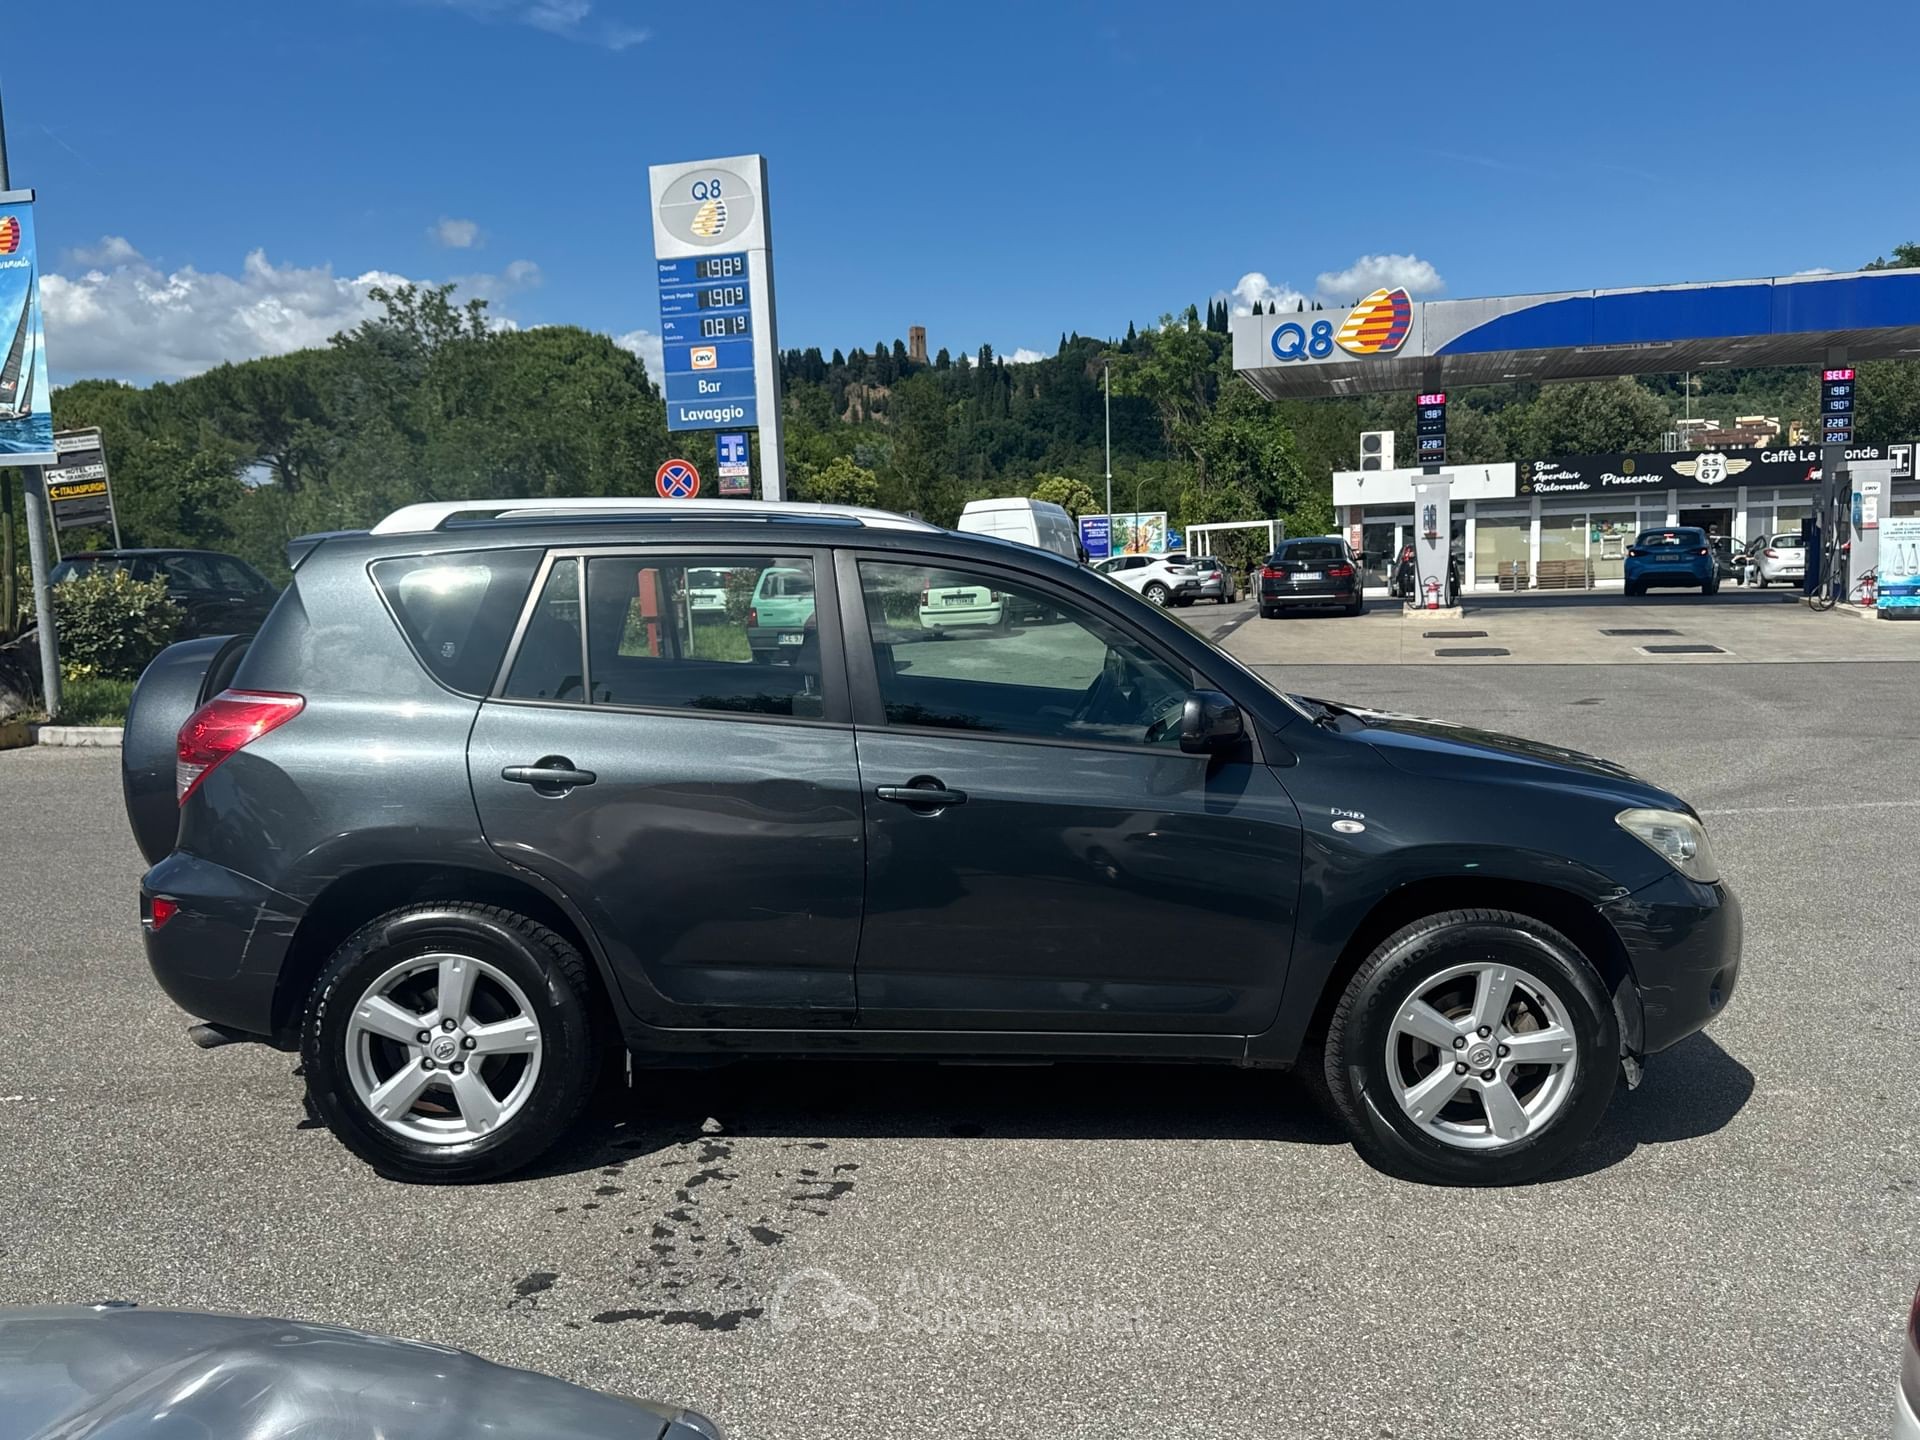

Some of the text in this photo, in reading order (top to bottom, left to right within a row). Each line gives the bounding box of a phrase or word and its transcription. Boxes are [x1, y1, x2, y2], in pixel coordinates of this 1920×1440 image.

[692, 179, 721, 201] Q8
[1271, 319, 1334, 361] Q8
[1827, 369, 1852, 380] SELF
[698, 380, 722, 394] Bar
[1420, 394, 1444, 405] SELF
[680, 405, 744, 422] Lavaggio
[1760, 446, 1880, 463] Caffè Le onde
[1534, 461, 1560, 471] Bar
[1702, 458, 1722, 467] S.S.
[1532, 470, 1581, 483] Aperitivi
[1600, 473, 1663, 486] Pinseria
[1701, 469, 1720, 480] 67
[1533, 481, 1591, 493] Ristorante
